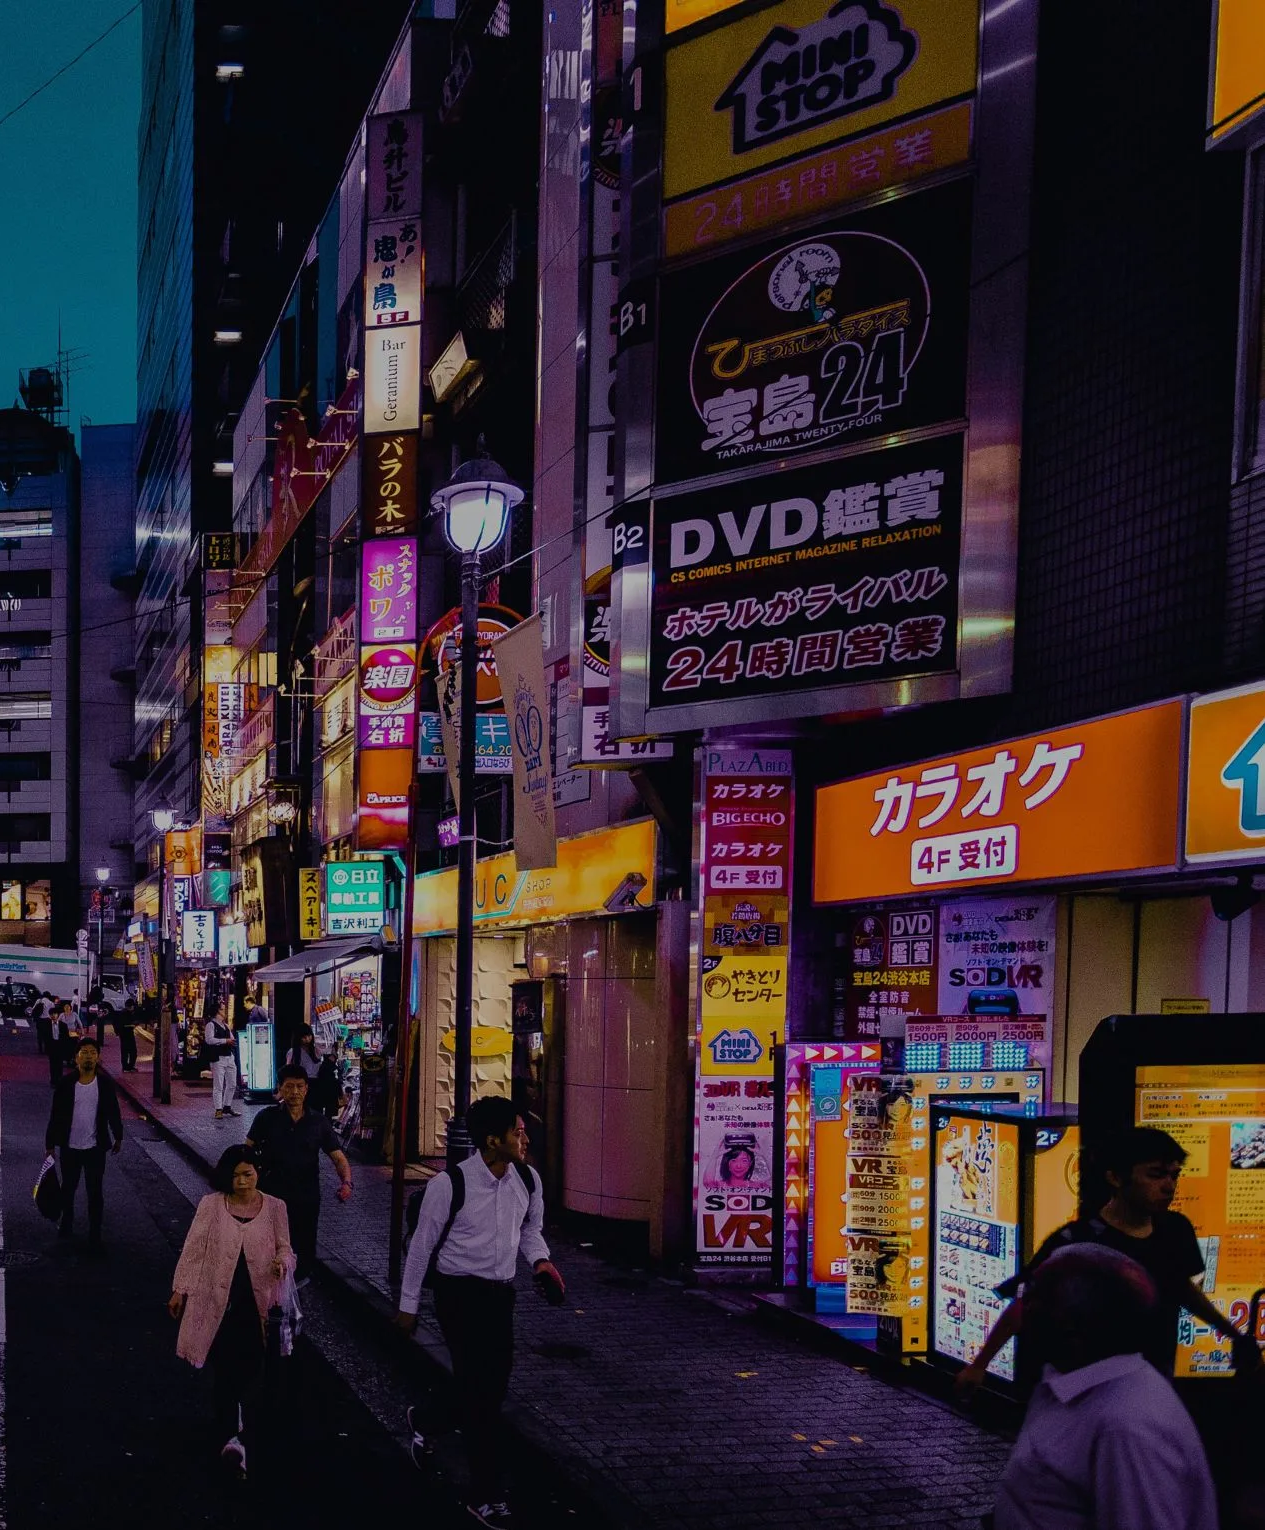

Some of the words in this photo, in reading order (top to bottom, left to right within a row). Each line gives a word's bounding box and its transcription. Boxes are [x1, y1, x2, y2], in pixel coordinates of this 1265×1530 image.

[761, 23, 869, 96] MINI
[755, 58, 875, 132] STOP
[692, 126, 935, 243] 24時間営業
[799, 248, 834, 263] room
[620, 300, 647, 337] B1
[382, 339, 406, 351] Bar
[383, 354, 398, 422] Geranium
[715, 435, 791, 461] TAKARAJIMA
[795, 421, 847, 441] TWENTY
[847, 412, 884, 431] FOUR
[376, 437, 407, 523] バラの木
[669, 468, 946, 569] DVD鑑賞
[613, 520, 645, 557] B2
[671, 572, 686, 584] CS
[688, 563, 733, 581] COMICS
[735, 551, 793, 572] INTERNET
[795, 540, 858, 561] MAGAZINE
[861, 523, 943, 550] RELAXATION
[396, 543, 414, 599] スナック
[661, 566, 949, 642] ホテルがライバル
[661, 614, 947, 692] 24時間営業
[363, 664, 415, 690] 楽園
[369, 729, 406, 745] 右折
[708, 751, 765, 773] PLAZA
[712, 783, 785, 799] カラオケ
[869, 742, 1085, 837] カラオケ
[712, 811, 741, 827] BIG
[743, 811, 786, 827] ECHO
[711, 842, 784, 857] カラオケ
[918, 844, 951, 875] 4F
[958, 837, 1008, 872] 受付
[352, 869, 380, 884] 日立
[525, 877, 552, 893] SHOP
[715, 869, 740, 884] 4F
[745, 869, 777, 885] 受付
[892, 913, 932, 937] DVD
[712, 922, 783, 947] 腹八分目
[890, 940, 931, 965] 鑑賞
[703, 958, 718, 970] 2F
[731, 969, 781, 985] やきとり
[852, 970, 931, 986] 宝島24渋谷本店
[732, 987, 783, 1003] センター
[868, 990, 910, 1004] 全室防音
[721, 1037, 751, 1049] MINI
[908, 1031, 948, 1042] 1500円
[955, 1031, 997, 1042] 2000円
[1002, 1030, 1044, 1041] 2500円
[719, 1050, 752, 1060] STOP
[1036, 1130, 1059, 1147] 2F
[852, 1158, 883, 1174] VR
[705, 1194, 772, 1211] SOD
[702, 1213, 773, 1249] VR
[848, 1236, 879, 1251] VR
